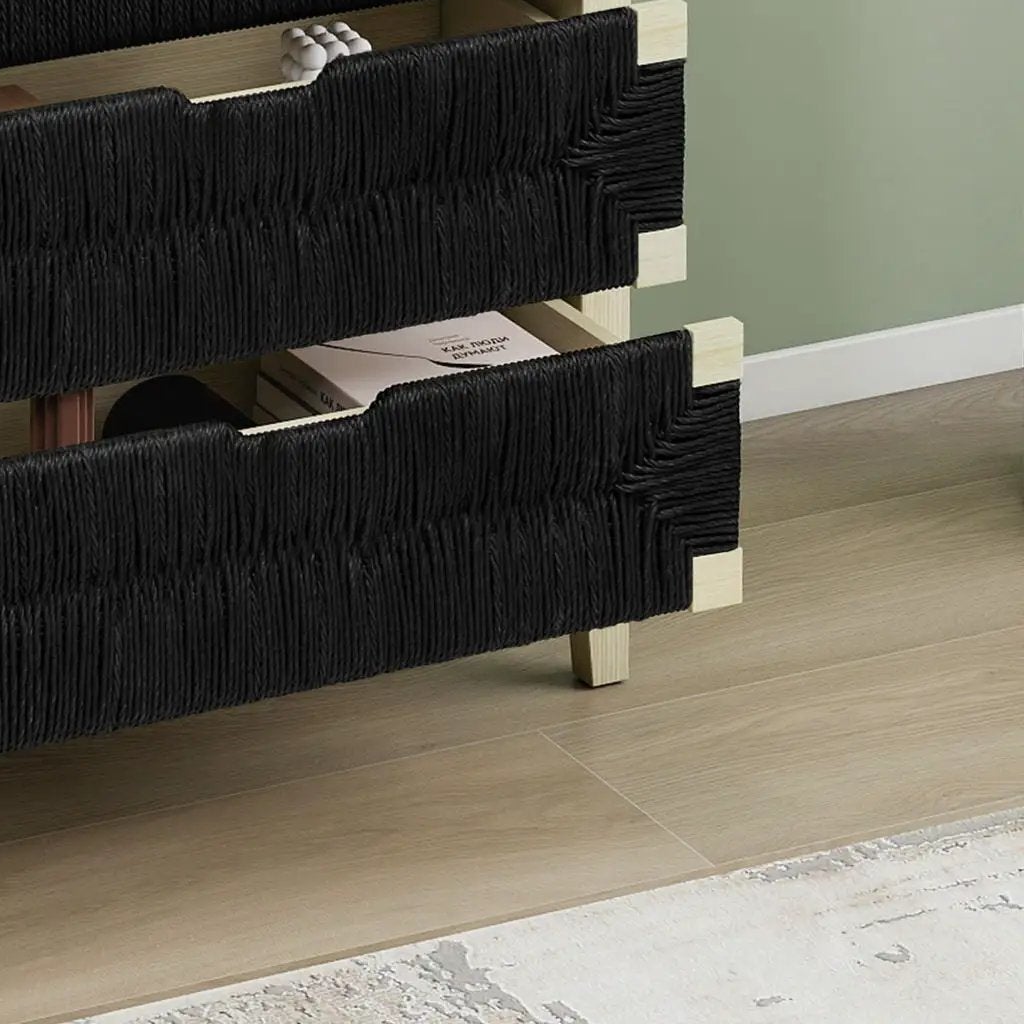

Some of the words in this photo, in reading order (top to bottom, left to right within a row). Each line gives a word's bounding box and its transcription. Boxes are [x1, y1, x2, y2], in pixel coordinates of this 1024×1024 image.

[441, 344, 465, 353] КАК
[470, 336, 510, 348] ЛЮДИ
[452, 344, 507, 360] ДУМАЮТ
